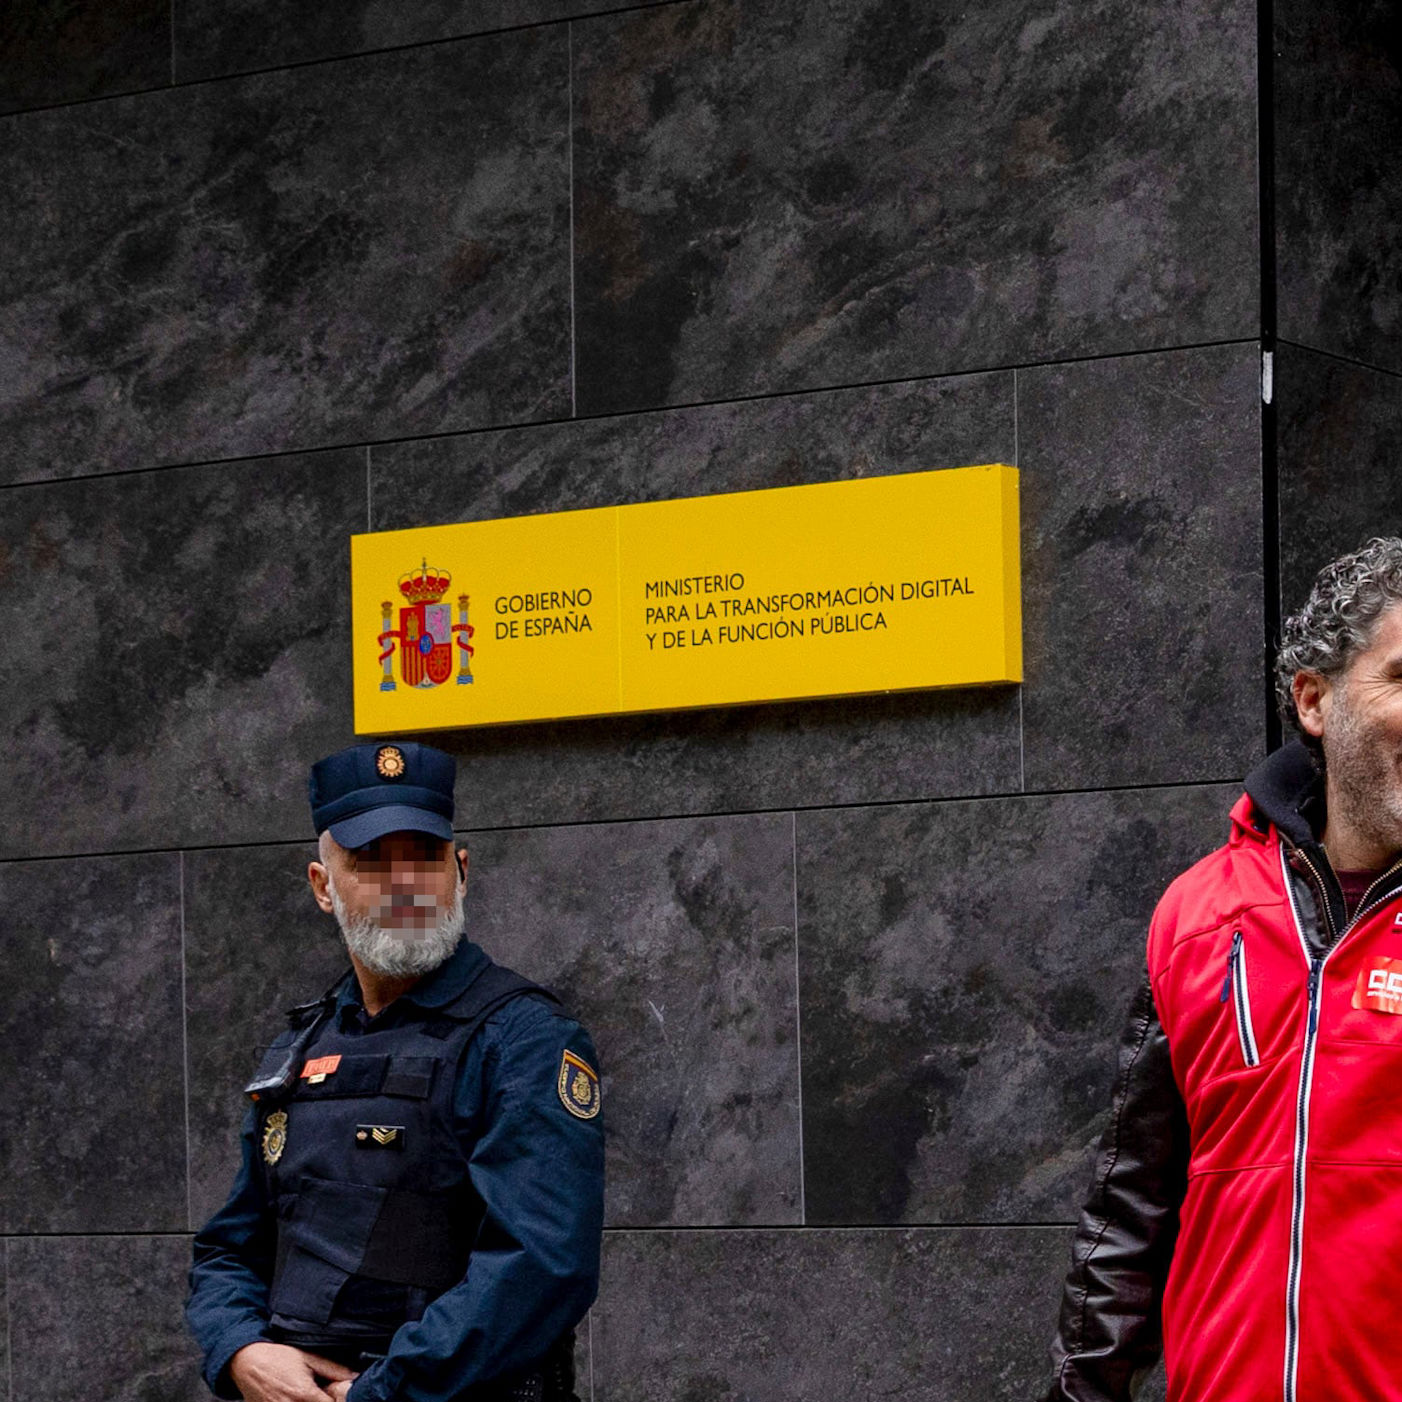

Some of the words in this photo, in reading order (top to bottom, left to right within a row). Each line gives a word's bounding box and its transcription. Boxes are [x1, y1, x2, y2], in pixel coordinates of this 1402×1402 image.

[494, 588, 593, 615] GOBIERNO
[645, 573, 745, 600] MINISTERIO
[645, 604, 691, 625] PARA
[695, 602, 717, 620] LA
[720, 581, 895, 618] TRANSFORMACIÓN
[900, 576, 975, 601] DIGITAL
[494, 621, 519, 640] DE
[524, 610, 593, 638] ESPAÑA
[645, 632, 657, 650] Y
[662, 630, 686, 649] DE
[691, 628, 713, 646] LA
[718, 616, 805, 644] FUNCIÓN
[810, 611, 888, 636] PÚBLICA
